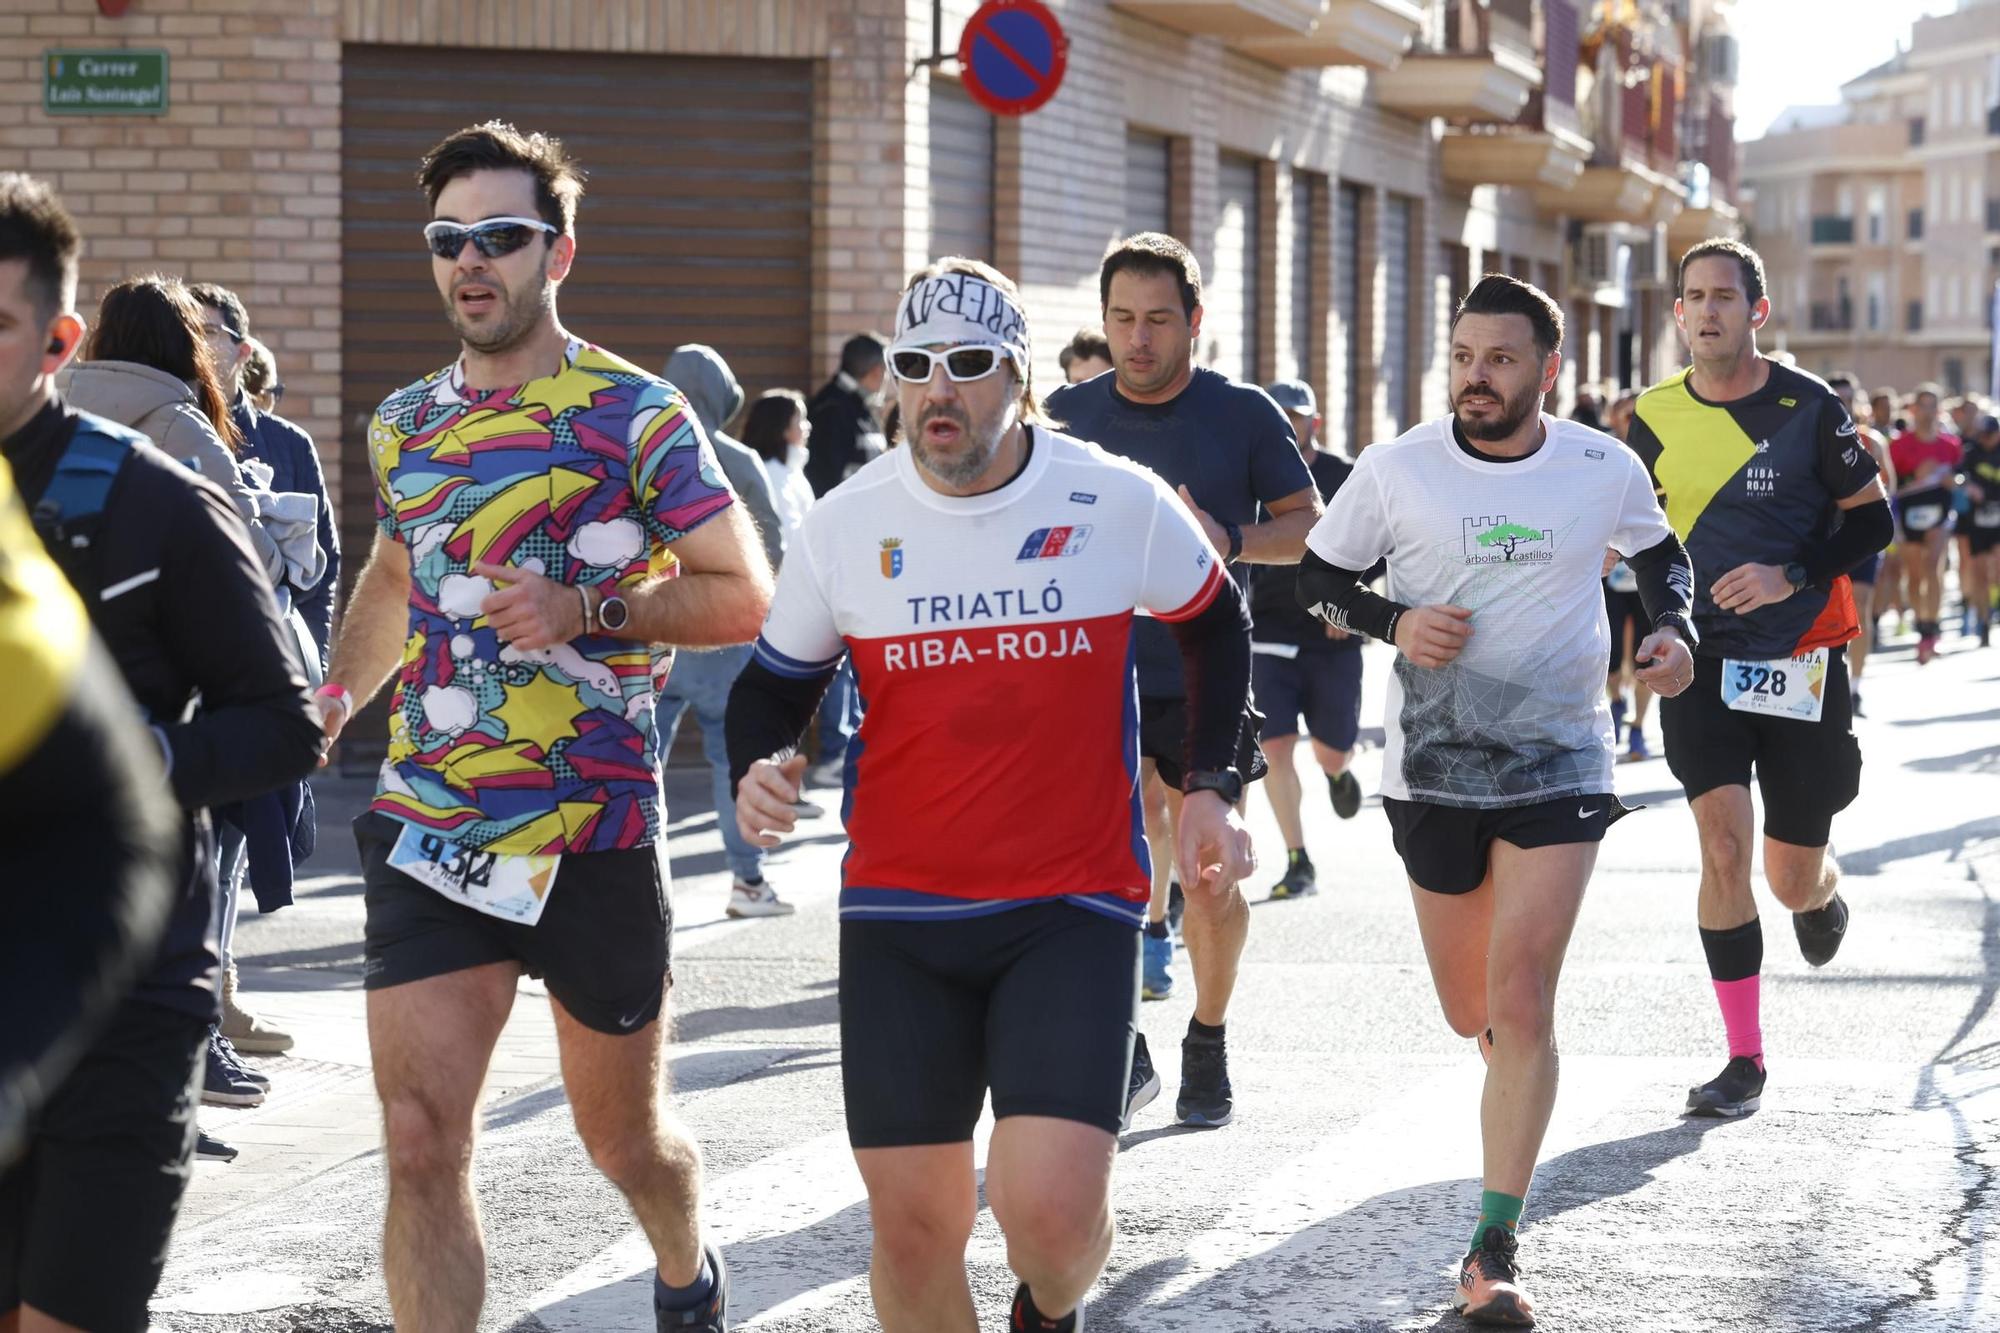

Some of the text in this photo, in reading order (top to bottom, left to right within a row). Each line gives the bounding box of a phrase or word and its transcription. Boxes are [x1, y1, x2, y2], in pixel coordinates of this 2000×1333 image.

[78, 57, 138, 77] Carrer
[1747, 467, 1781, 479] RIBA-
[1746, 480, 1774, 491] ROJA
[1513, 550, 1553, 561] castillos
[907, 579, 1063, 625] TRIATLÓ
[884, 626, 1092, 672] RIBA-ROJA
[1735, 665, 1787, 697] 328
